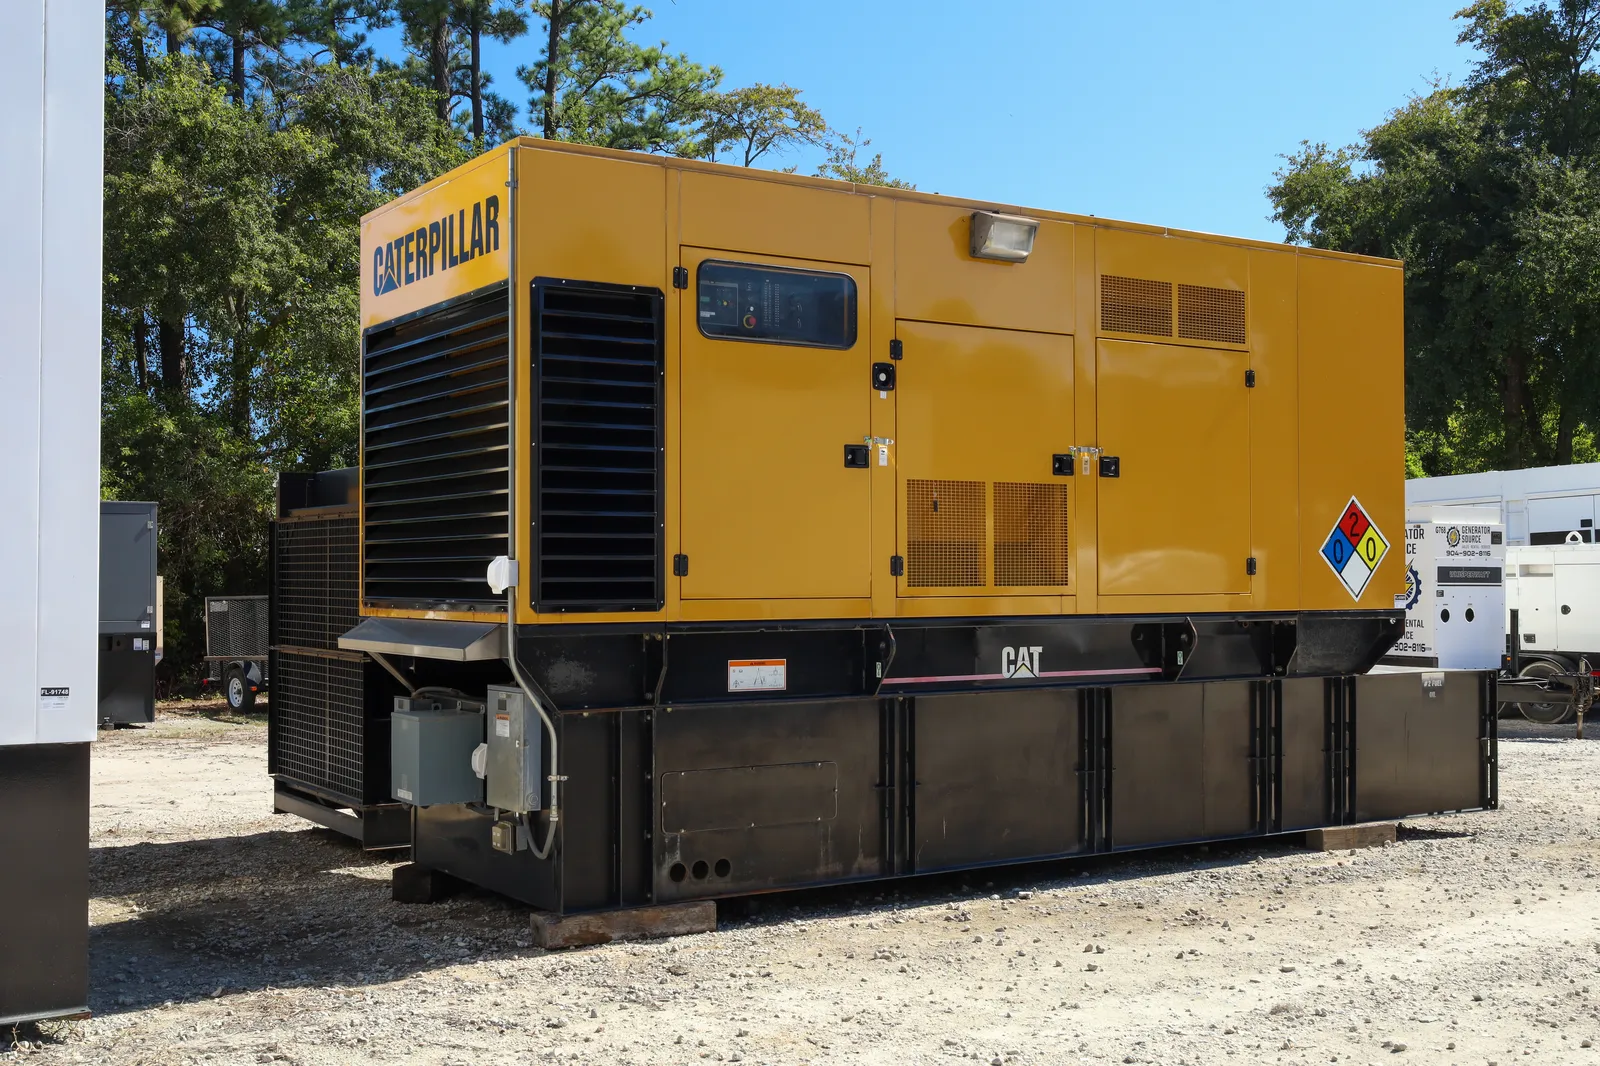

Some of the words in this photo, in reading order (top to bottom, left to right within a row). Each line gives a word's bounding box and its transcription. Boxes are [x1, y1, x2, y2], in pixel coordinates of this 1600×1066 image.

[373, 195, 499, 297] CATERPILLAR
[1349, 512, 1359, 537] 2
[1461, 526, 1491, 534] GENERATOR
[1405, 528, 1425, 539] ATOR
[1461, 535, 1482, 543] SOURCE
[1333, 539, 1343, 564] 0
[1366, 537, 1376, 562] 0
[1406, 543, 1416, 554] CE
[1405, 619, 1424, 628] ENTAL
[1394, 642, 1426, 653] 902-8116
[1001, 646, 1043, 678] CAT
